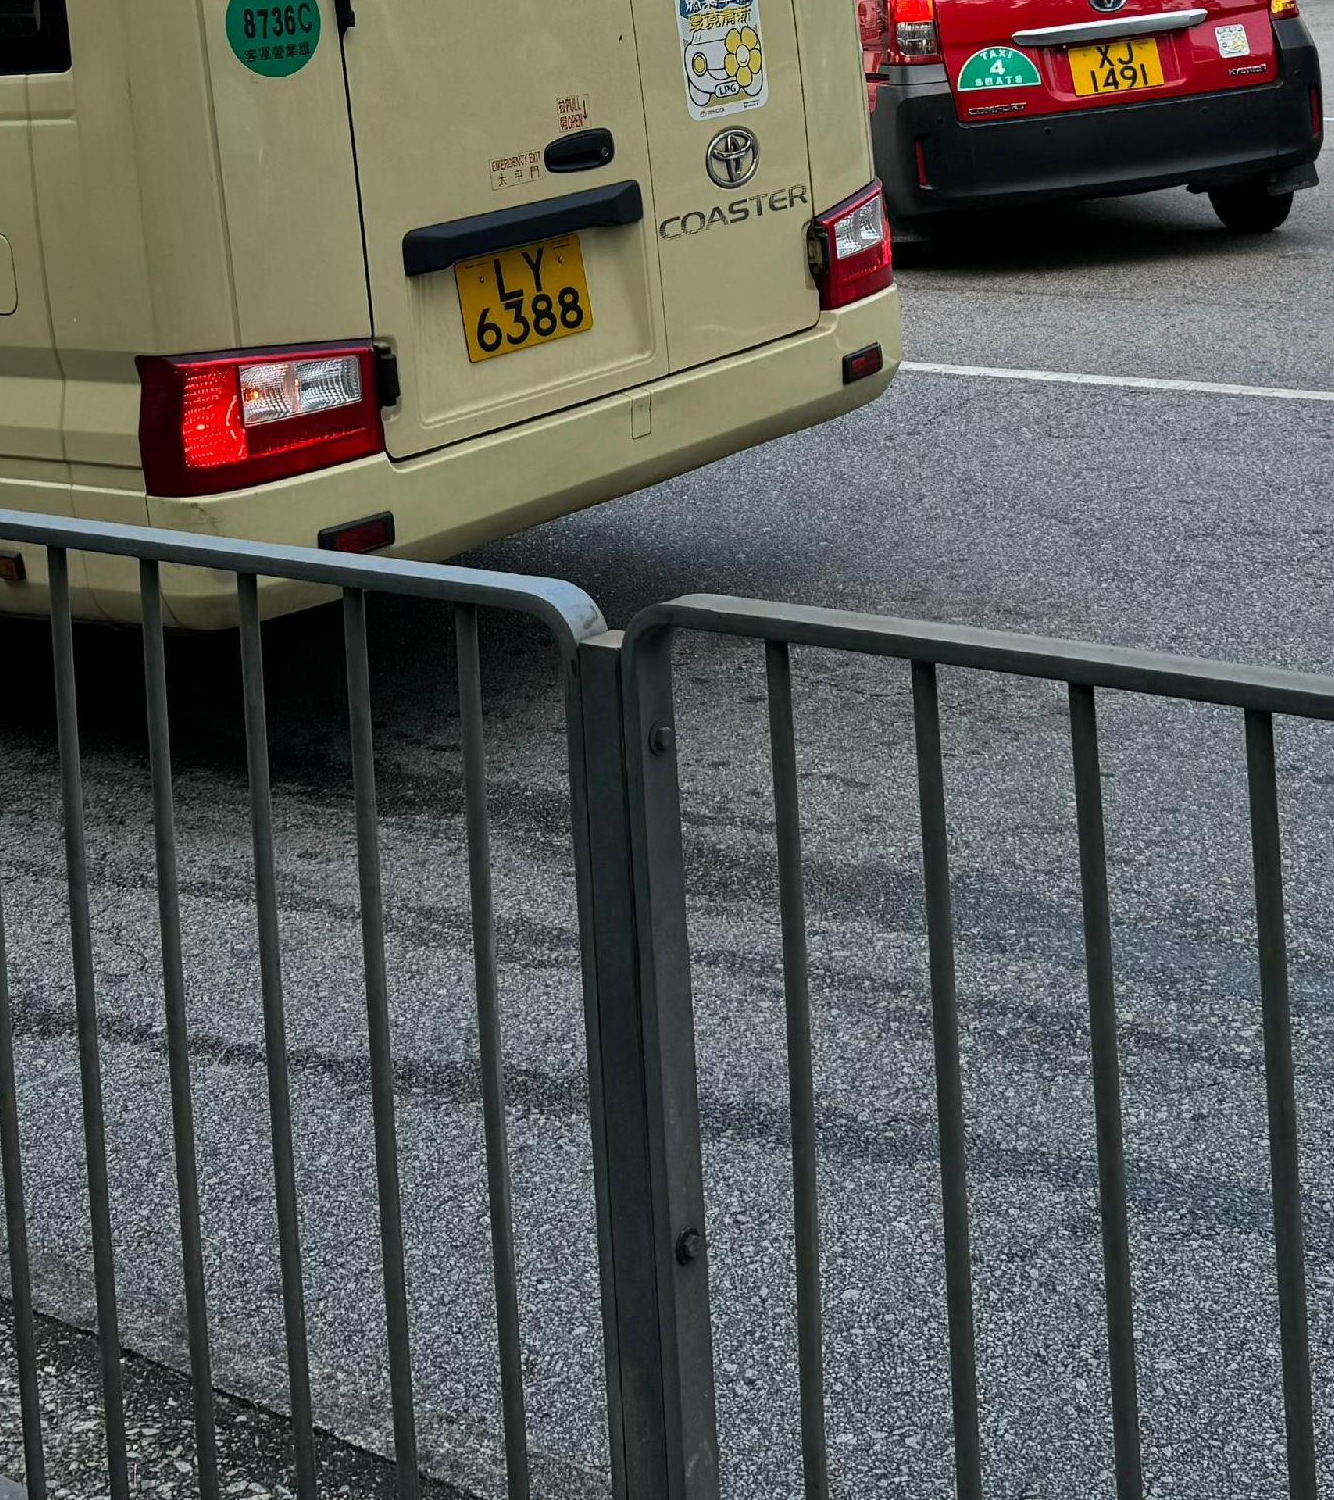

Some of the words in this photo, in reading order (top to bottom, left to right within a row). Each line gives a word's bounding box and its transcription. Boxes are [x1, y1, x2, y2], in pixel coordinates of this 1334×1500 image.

[243, 2, 313, 39] 8736C
[979, 49, 1013, 61] TAXI
[989, 59, 1006, 75] 4
[1095, 42, 1135, 69] XJ
[718, 83, 737, 96] LPG
[975, 74, 1023, 87] SEATS
[1090, 63, 1148, 93] 1491
[658, 184, 808, 240] COASTER
[493, 247, 545, 302] LY
[477, 286, 584, 352] 6388
